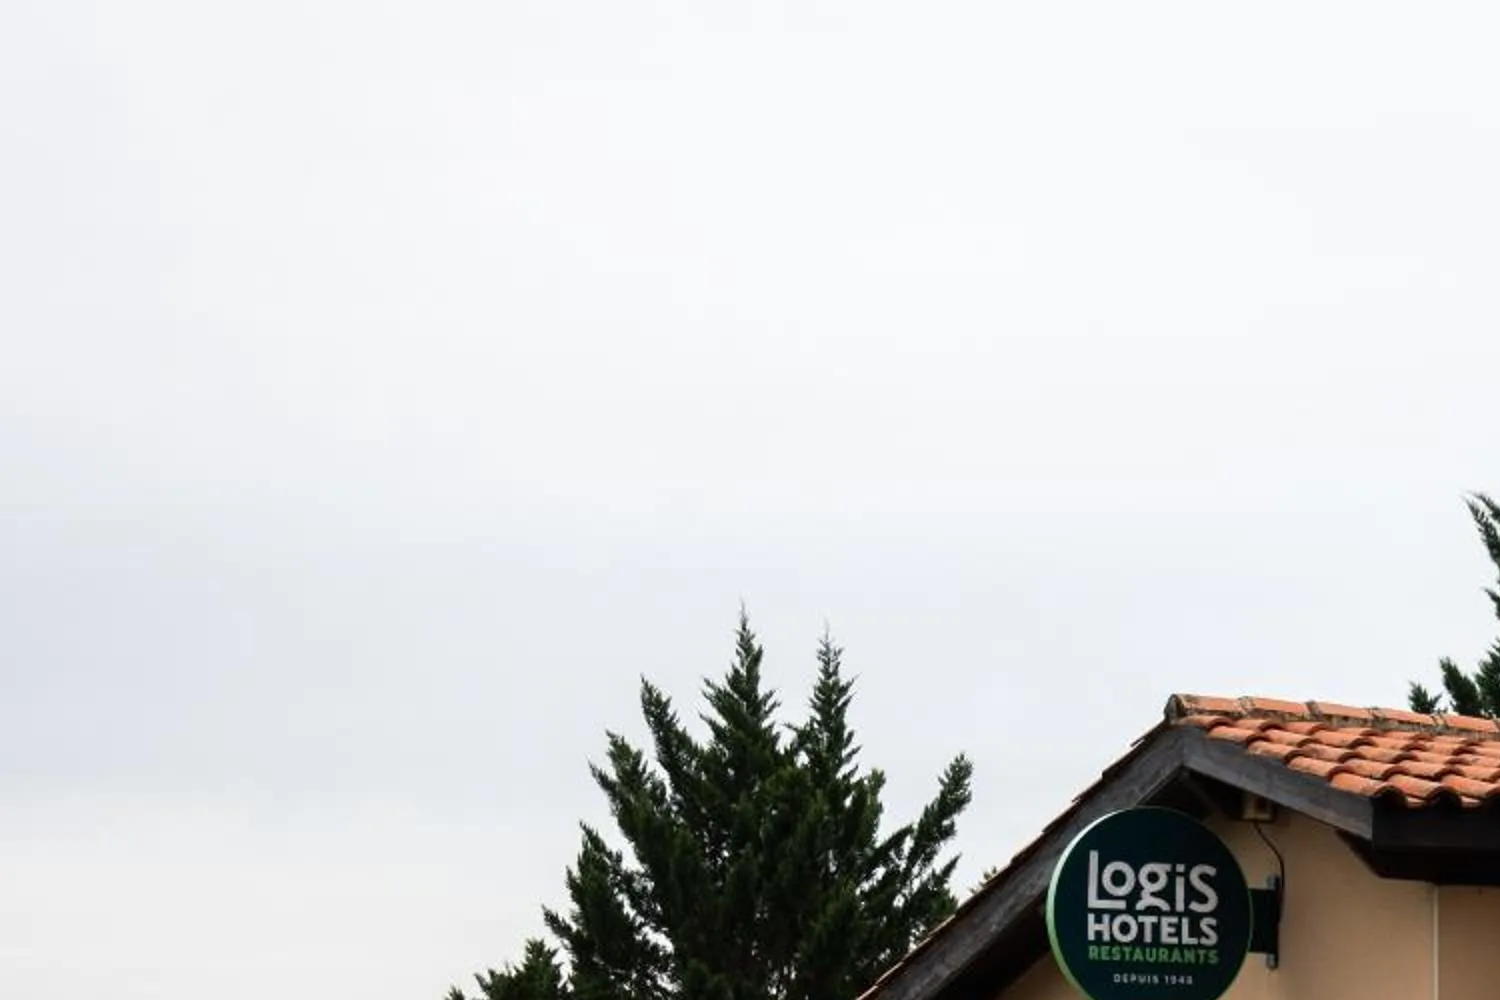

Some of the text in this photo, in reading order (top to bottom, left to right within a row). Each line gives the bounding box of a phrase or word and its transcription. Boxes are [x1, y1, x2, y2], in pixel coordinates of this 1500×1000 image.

[1087, 913, 1218, 946] HOTELS
[1088, 945, 1219, 965] RESTAURANTS
[1113, 973, 1159, 984] DEPUIS
